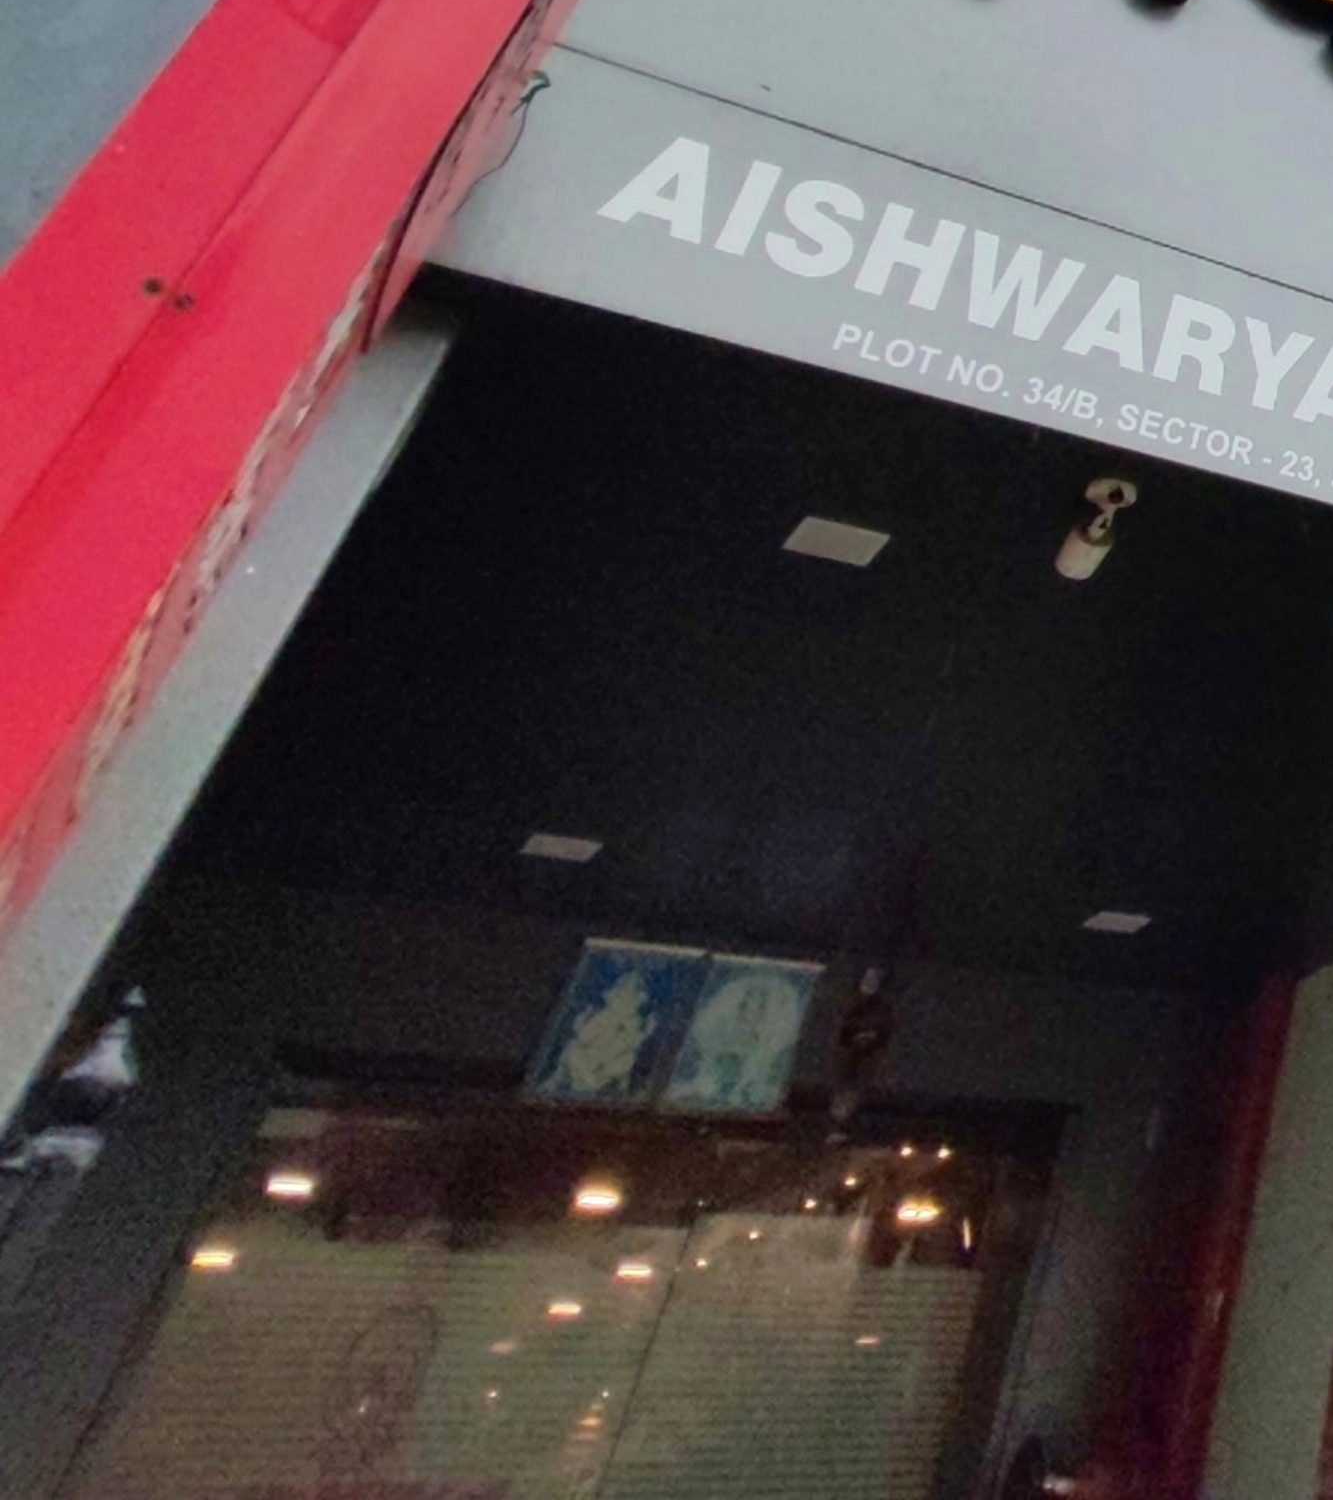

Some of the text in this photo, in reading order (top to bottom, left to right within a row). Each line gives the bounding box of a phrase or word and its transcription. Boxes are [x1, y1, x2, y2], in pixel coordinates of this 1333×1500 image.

[832, 323, 942, 376] PLOT
[947, 355, 1010, 398] NO.
[1022, 377, 1103, 428] 34/B,
[1116, 403, 1254, 465] SECTOR
[1280, 449, 1322, 489] 23,
